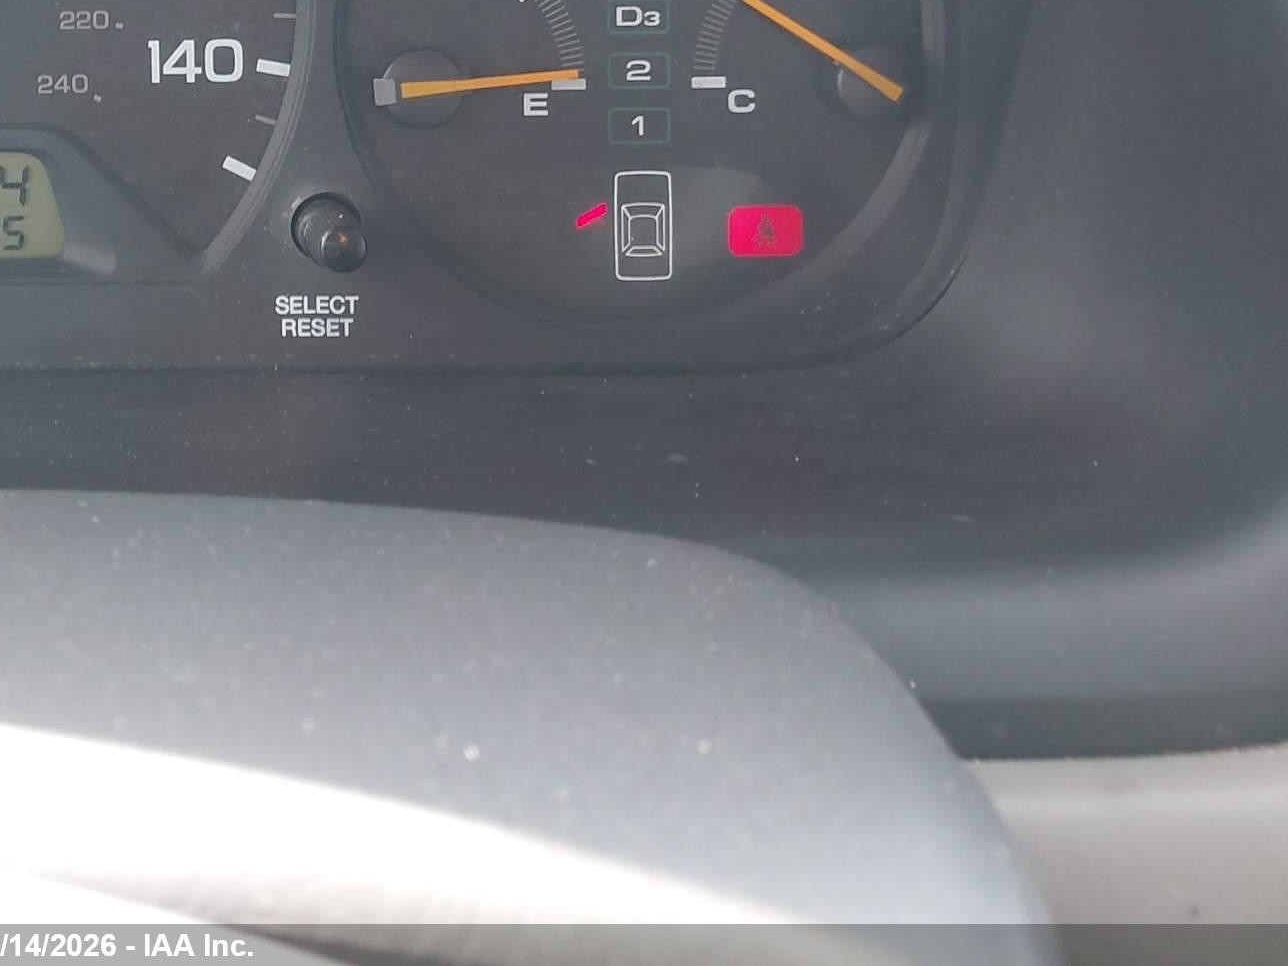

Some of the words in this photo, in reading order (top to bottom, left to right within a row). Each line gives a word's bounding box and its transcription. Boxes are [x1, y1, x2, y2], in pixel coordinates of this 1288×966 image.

[59, 10, 109, 30] 220
[615, 6, 661, 27] D3
[148, 38, 244, 83] 140
[626, 61, 651, 81] 2
[37, 74, 88, 94] 240
[523, 93, 549, 116] E
[728, 89, 755, 114] C
[631, 116, 645, 136] 1
[275, 296, 359, 315] SELECT
[281, 318, 354, 337] RESET
